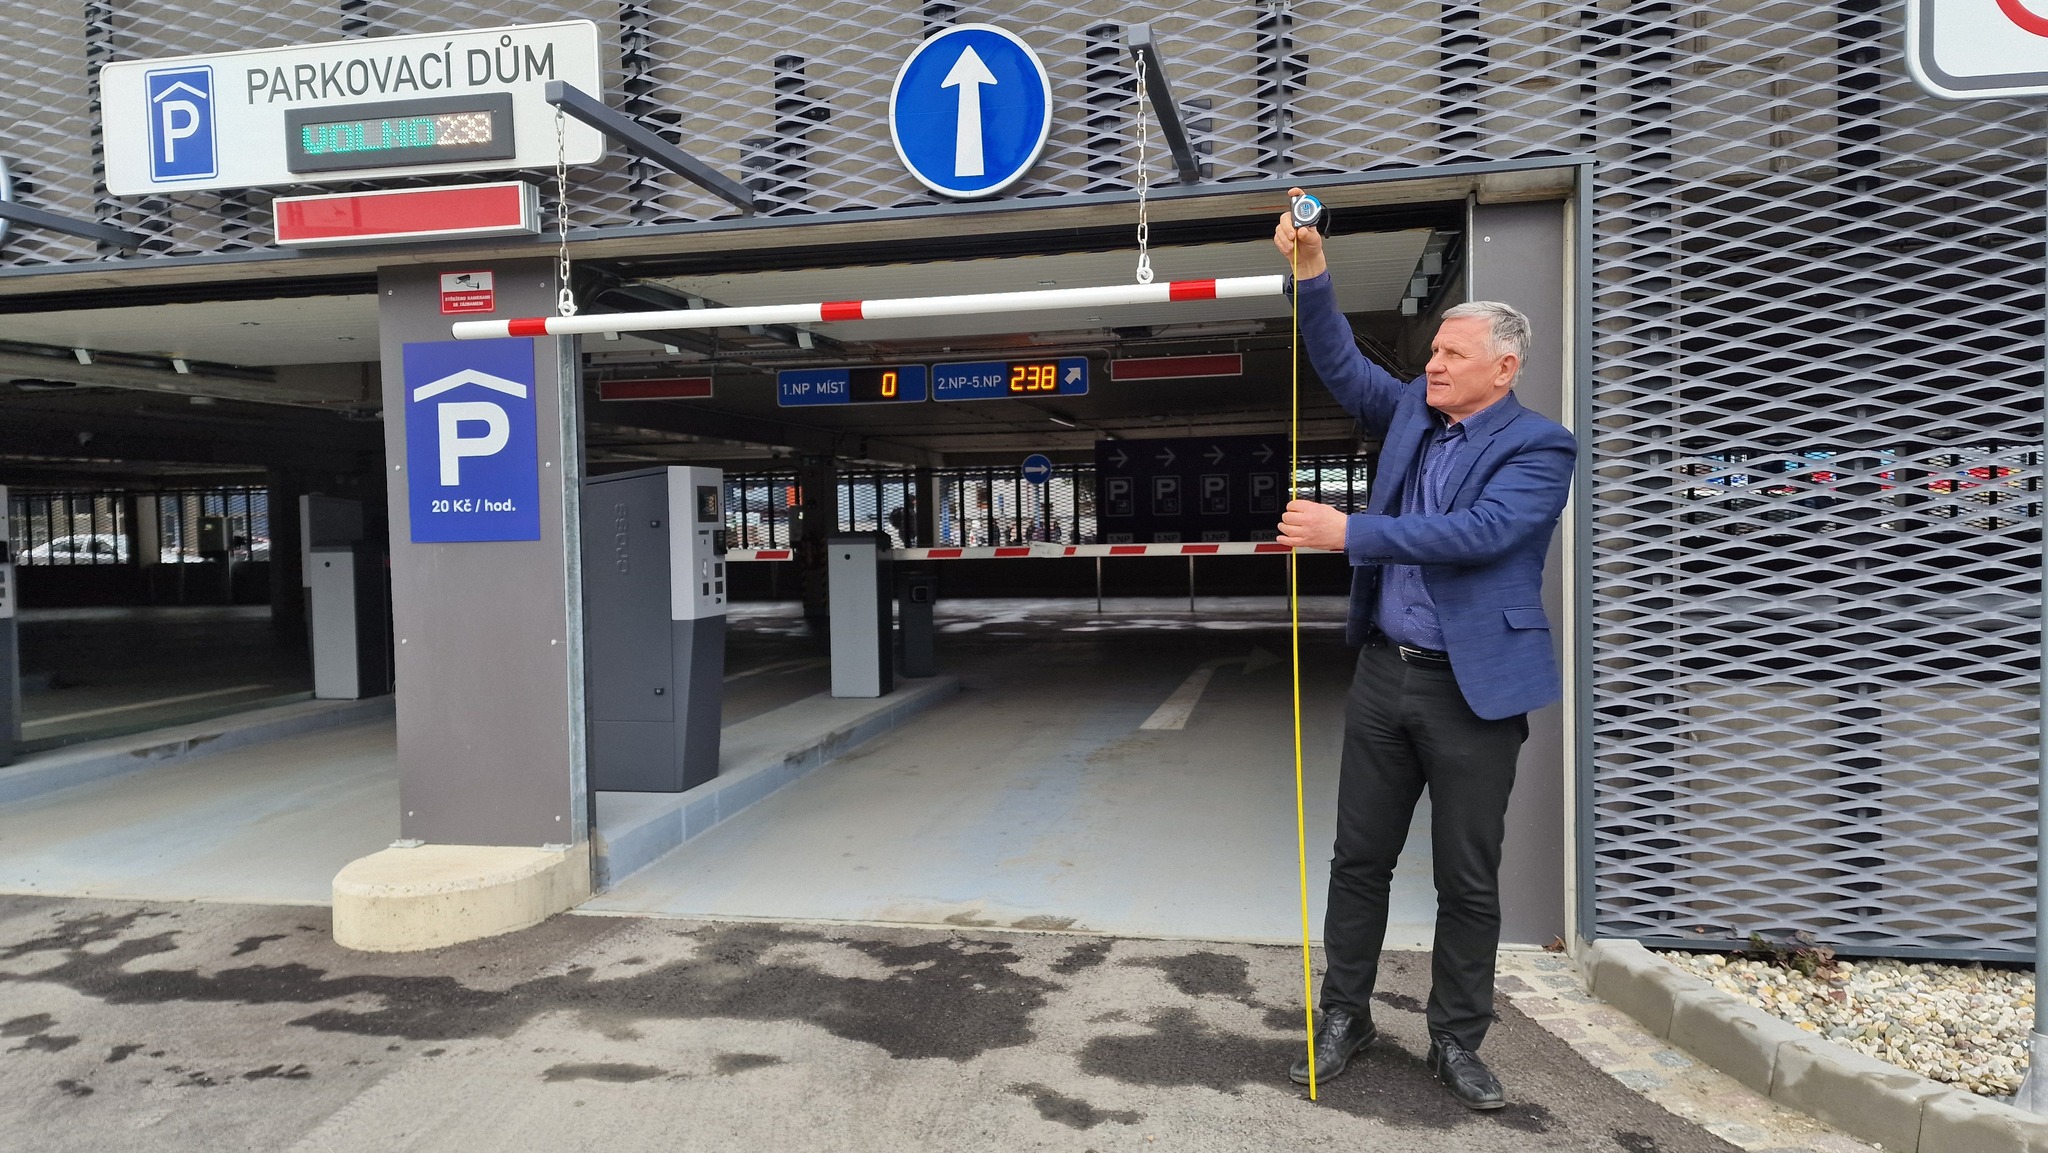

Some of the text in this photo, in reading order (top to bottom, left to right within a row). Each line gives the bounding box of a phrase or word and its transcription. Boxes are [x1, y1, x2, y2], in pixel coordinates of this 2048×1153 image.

[246, 34, 555, 105] PARKOVACÍ DŮM
[162, 100, 200, 163] P
[783, 379, 846, 395] 1.NP MÍST
[881, 373, 896, 397] 0
[937, 374, 1002, 390] 2.NP-5.NP
[1010, 365, 1056, 392] 238
[438, 402, 509, 485] P
[1109, 480, 1129, 501] P
[1156, 479, 1177, 500] P
[1204, 477, 1225, 499] P
[1252, 475, 1275, 497] P
[431, 499, 449, 513] 20
[453, 498, 472, 513] Kč
[484, 498, 516, 512] hod.
